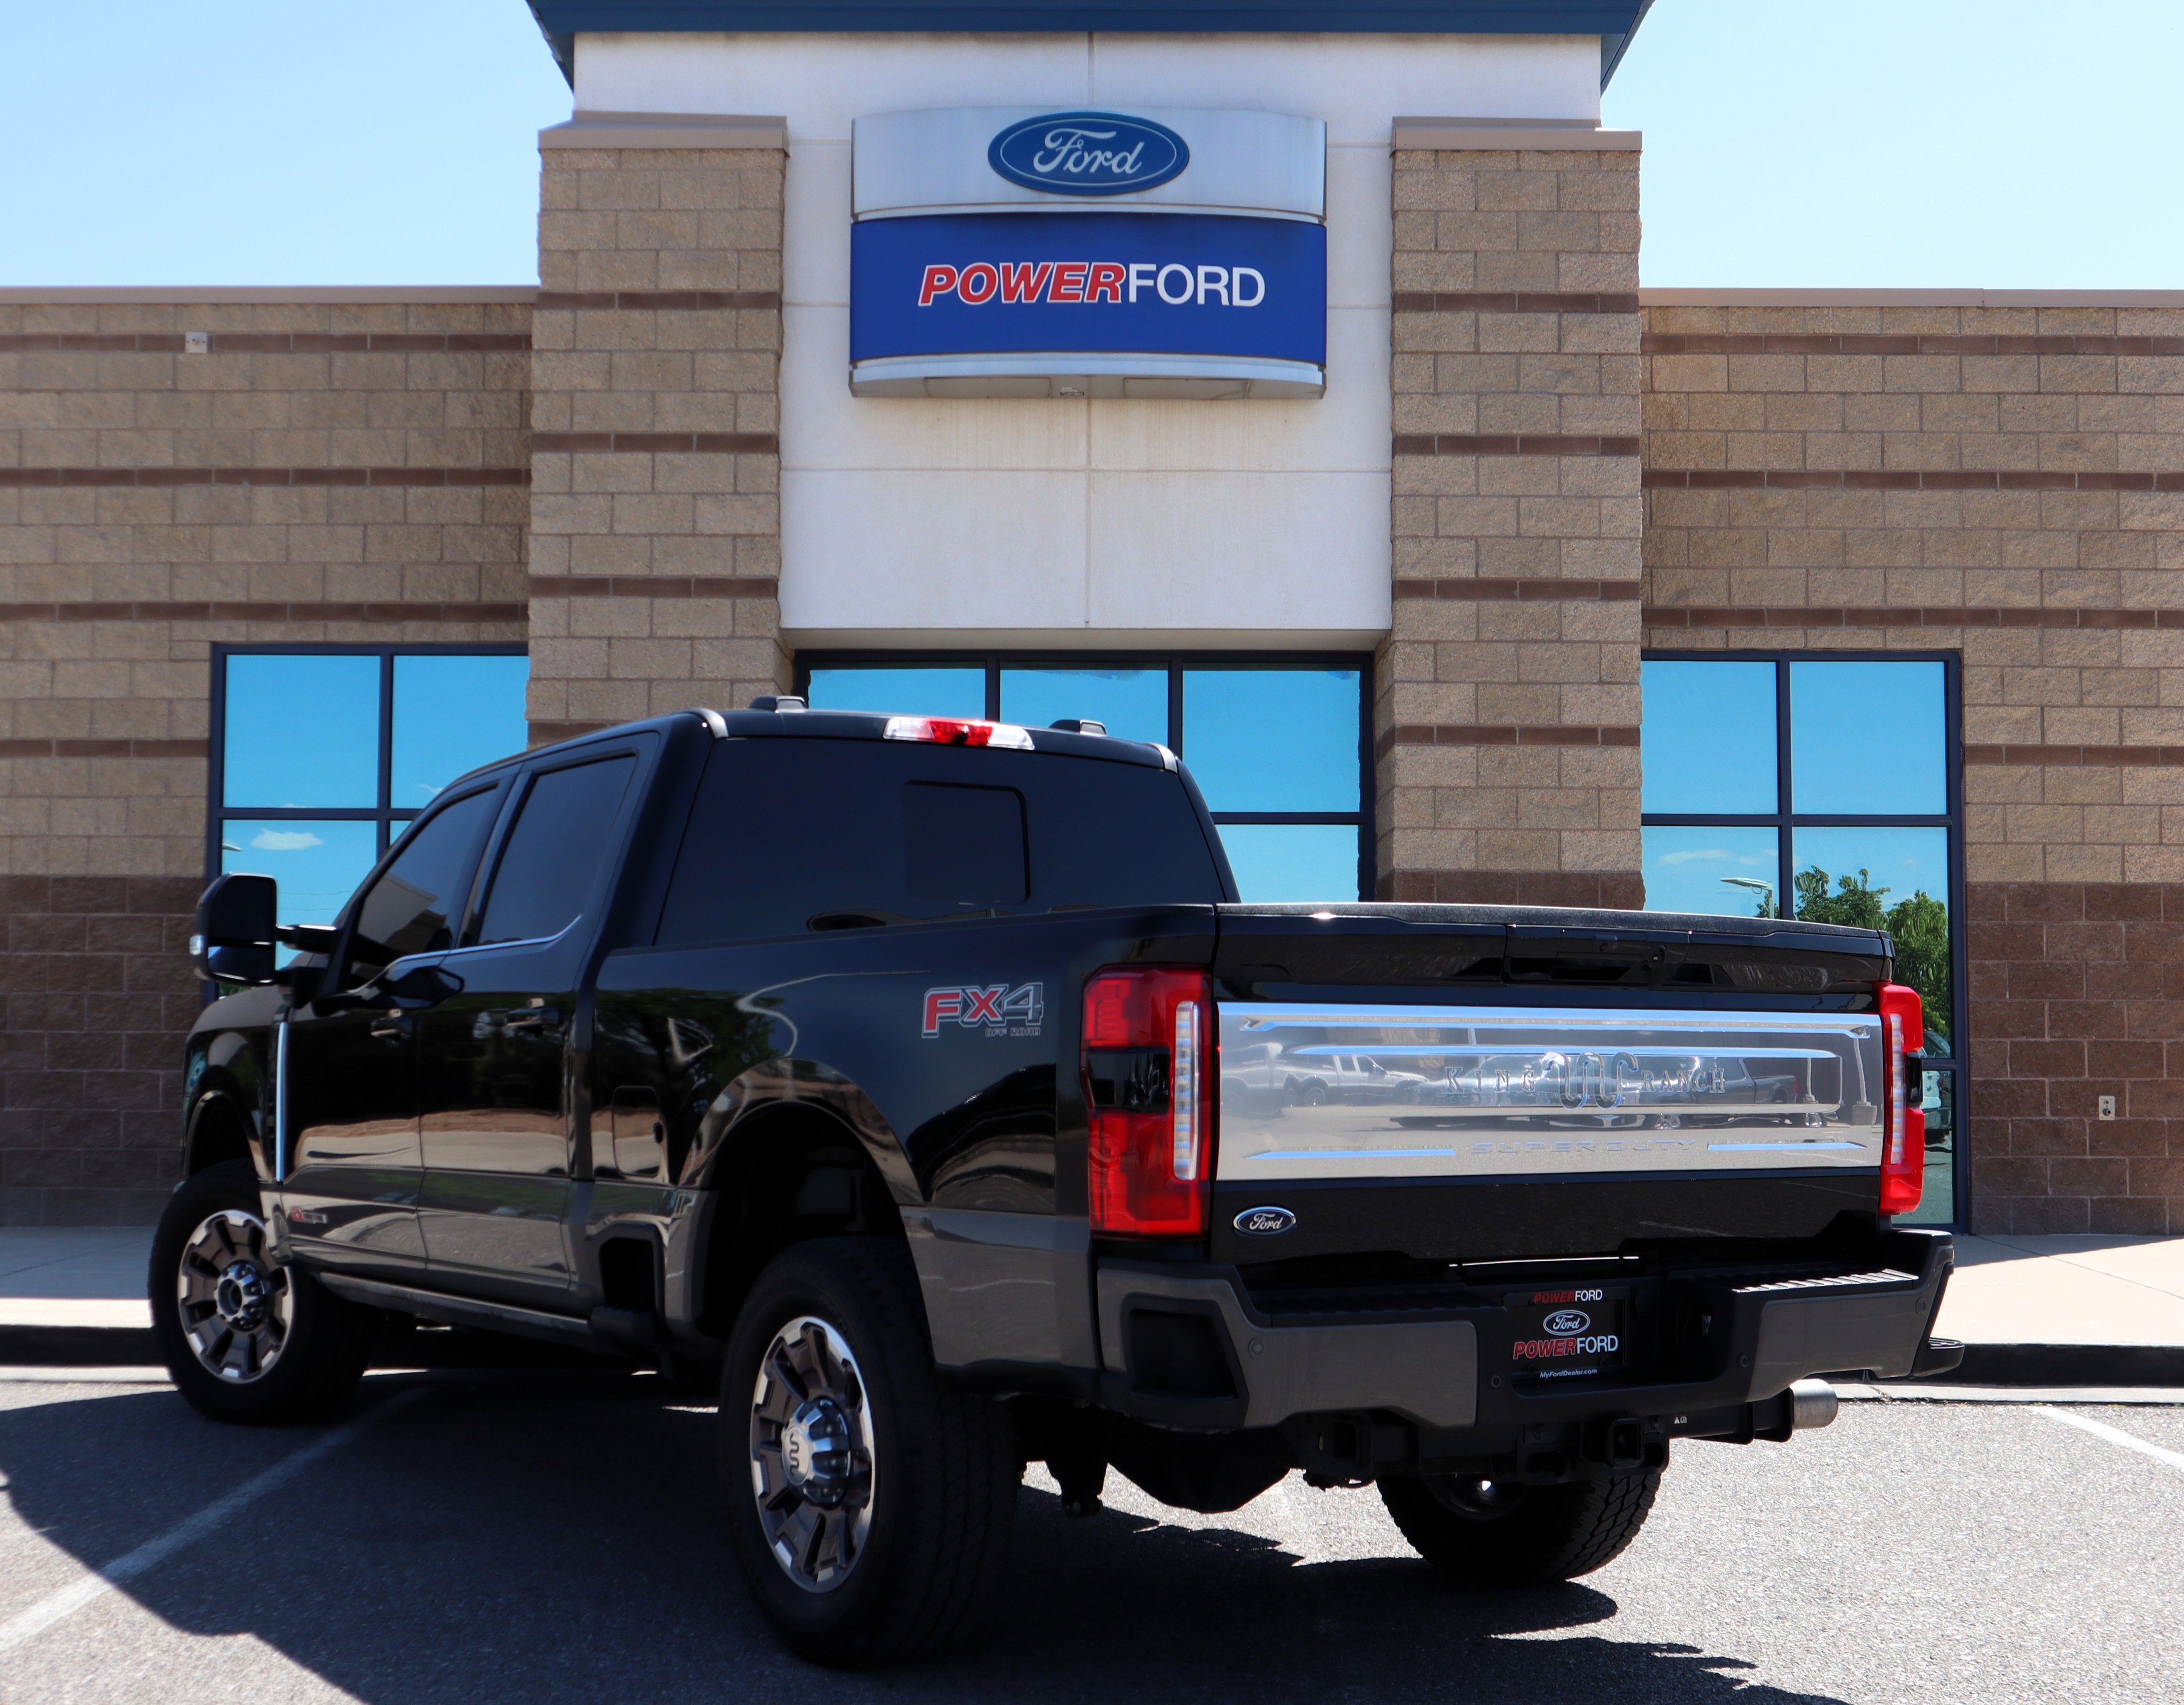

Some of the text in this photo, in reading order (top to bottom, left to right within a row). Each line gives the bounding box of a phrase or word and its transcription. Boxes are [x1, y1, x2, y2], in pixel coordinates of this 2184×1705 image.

[1033, 128, 1145, 174] Ford
[918, 262, 1266, 307] POWERFORD
[921, 982, 1044, 1039] FX4
[985, 1027, 1041, 1037] OFF ROAD
[1444, 1067, 1725, 1094] KING RANCH
[1471, 1139, 1696, 1154] SUPER DUTY
[1249, 1213, 1284, 1230] Ford
[1533, 1289, 1603, 1304] POWERFORD
[1552, 1315, 1581, 1330] Ford
[1513, 1335, 1619, 1360] POWERFORD
[1539, 1369, 1598, 1379] MyFordDealer.com
